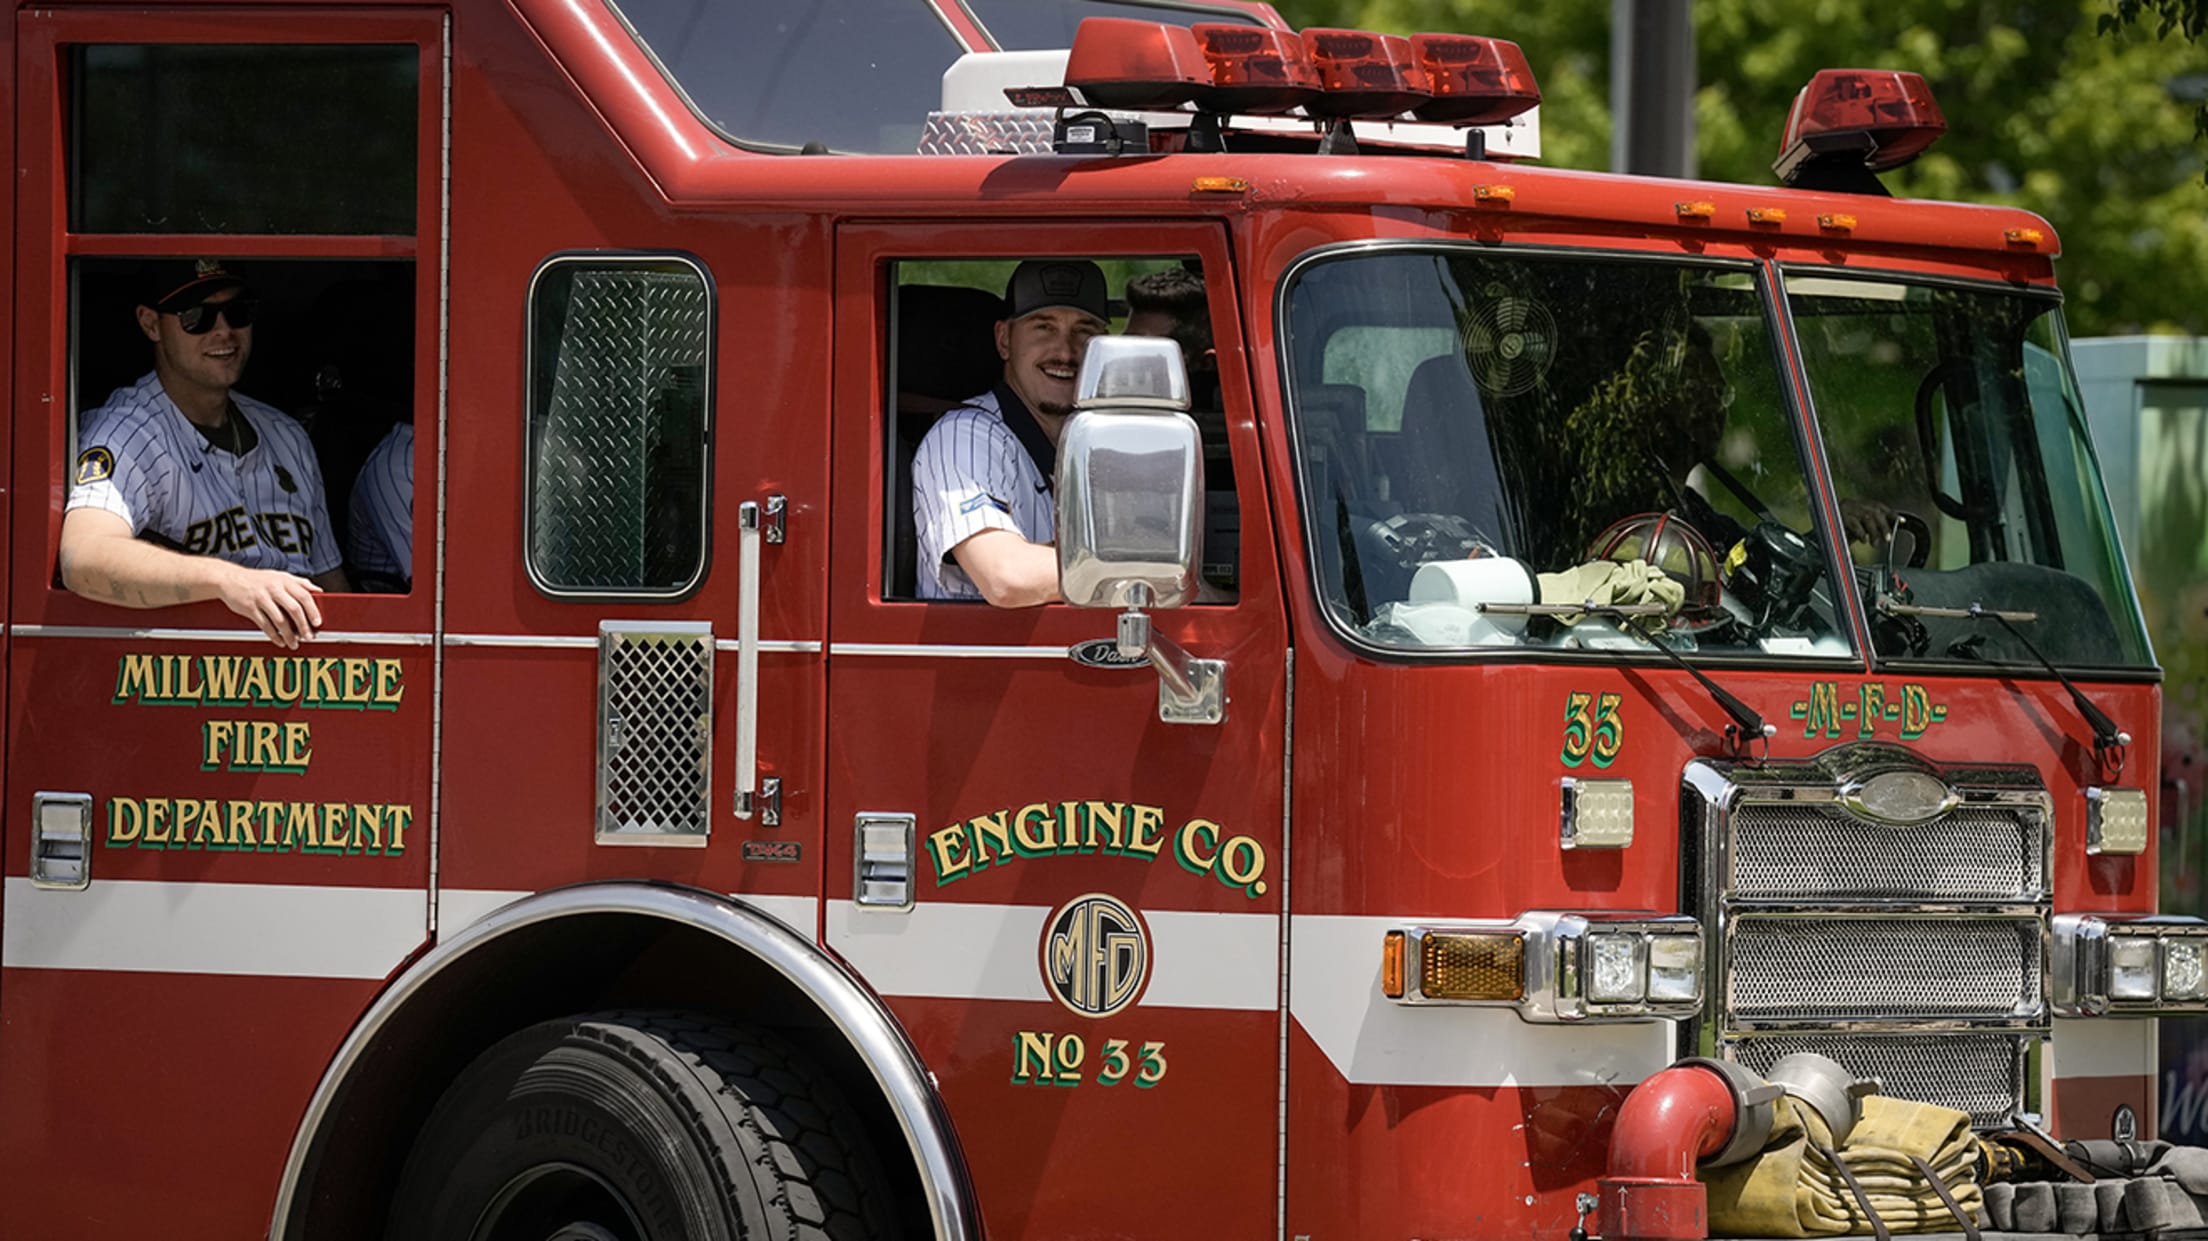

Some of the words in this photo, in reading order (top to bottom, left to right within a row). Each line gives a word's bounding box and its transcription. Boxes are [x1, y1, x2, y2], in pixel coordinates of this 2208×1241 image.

[184, 505, 314, 556] BREER
[112, 655, 405, 711] MILWAUKEE
[201, 720, 312, 775] FIRE
[1560, 690, 1622, 769] 33
[105, 797, 413, 856] DEPARTMENT
[925, 799, 1166, 888] ENGINE
[1052, 901, 1140, 1011] MFD
[1097, 1038, 1167, 1088] 33
[515, 1103, 674, 1239] BRIDGESTONE
